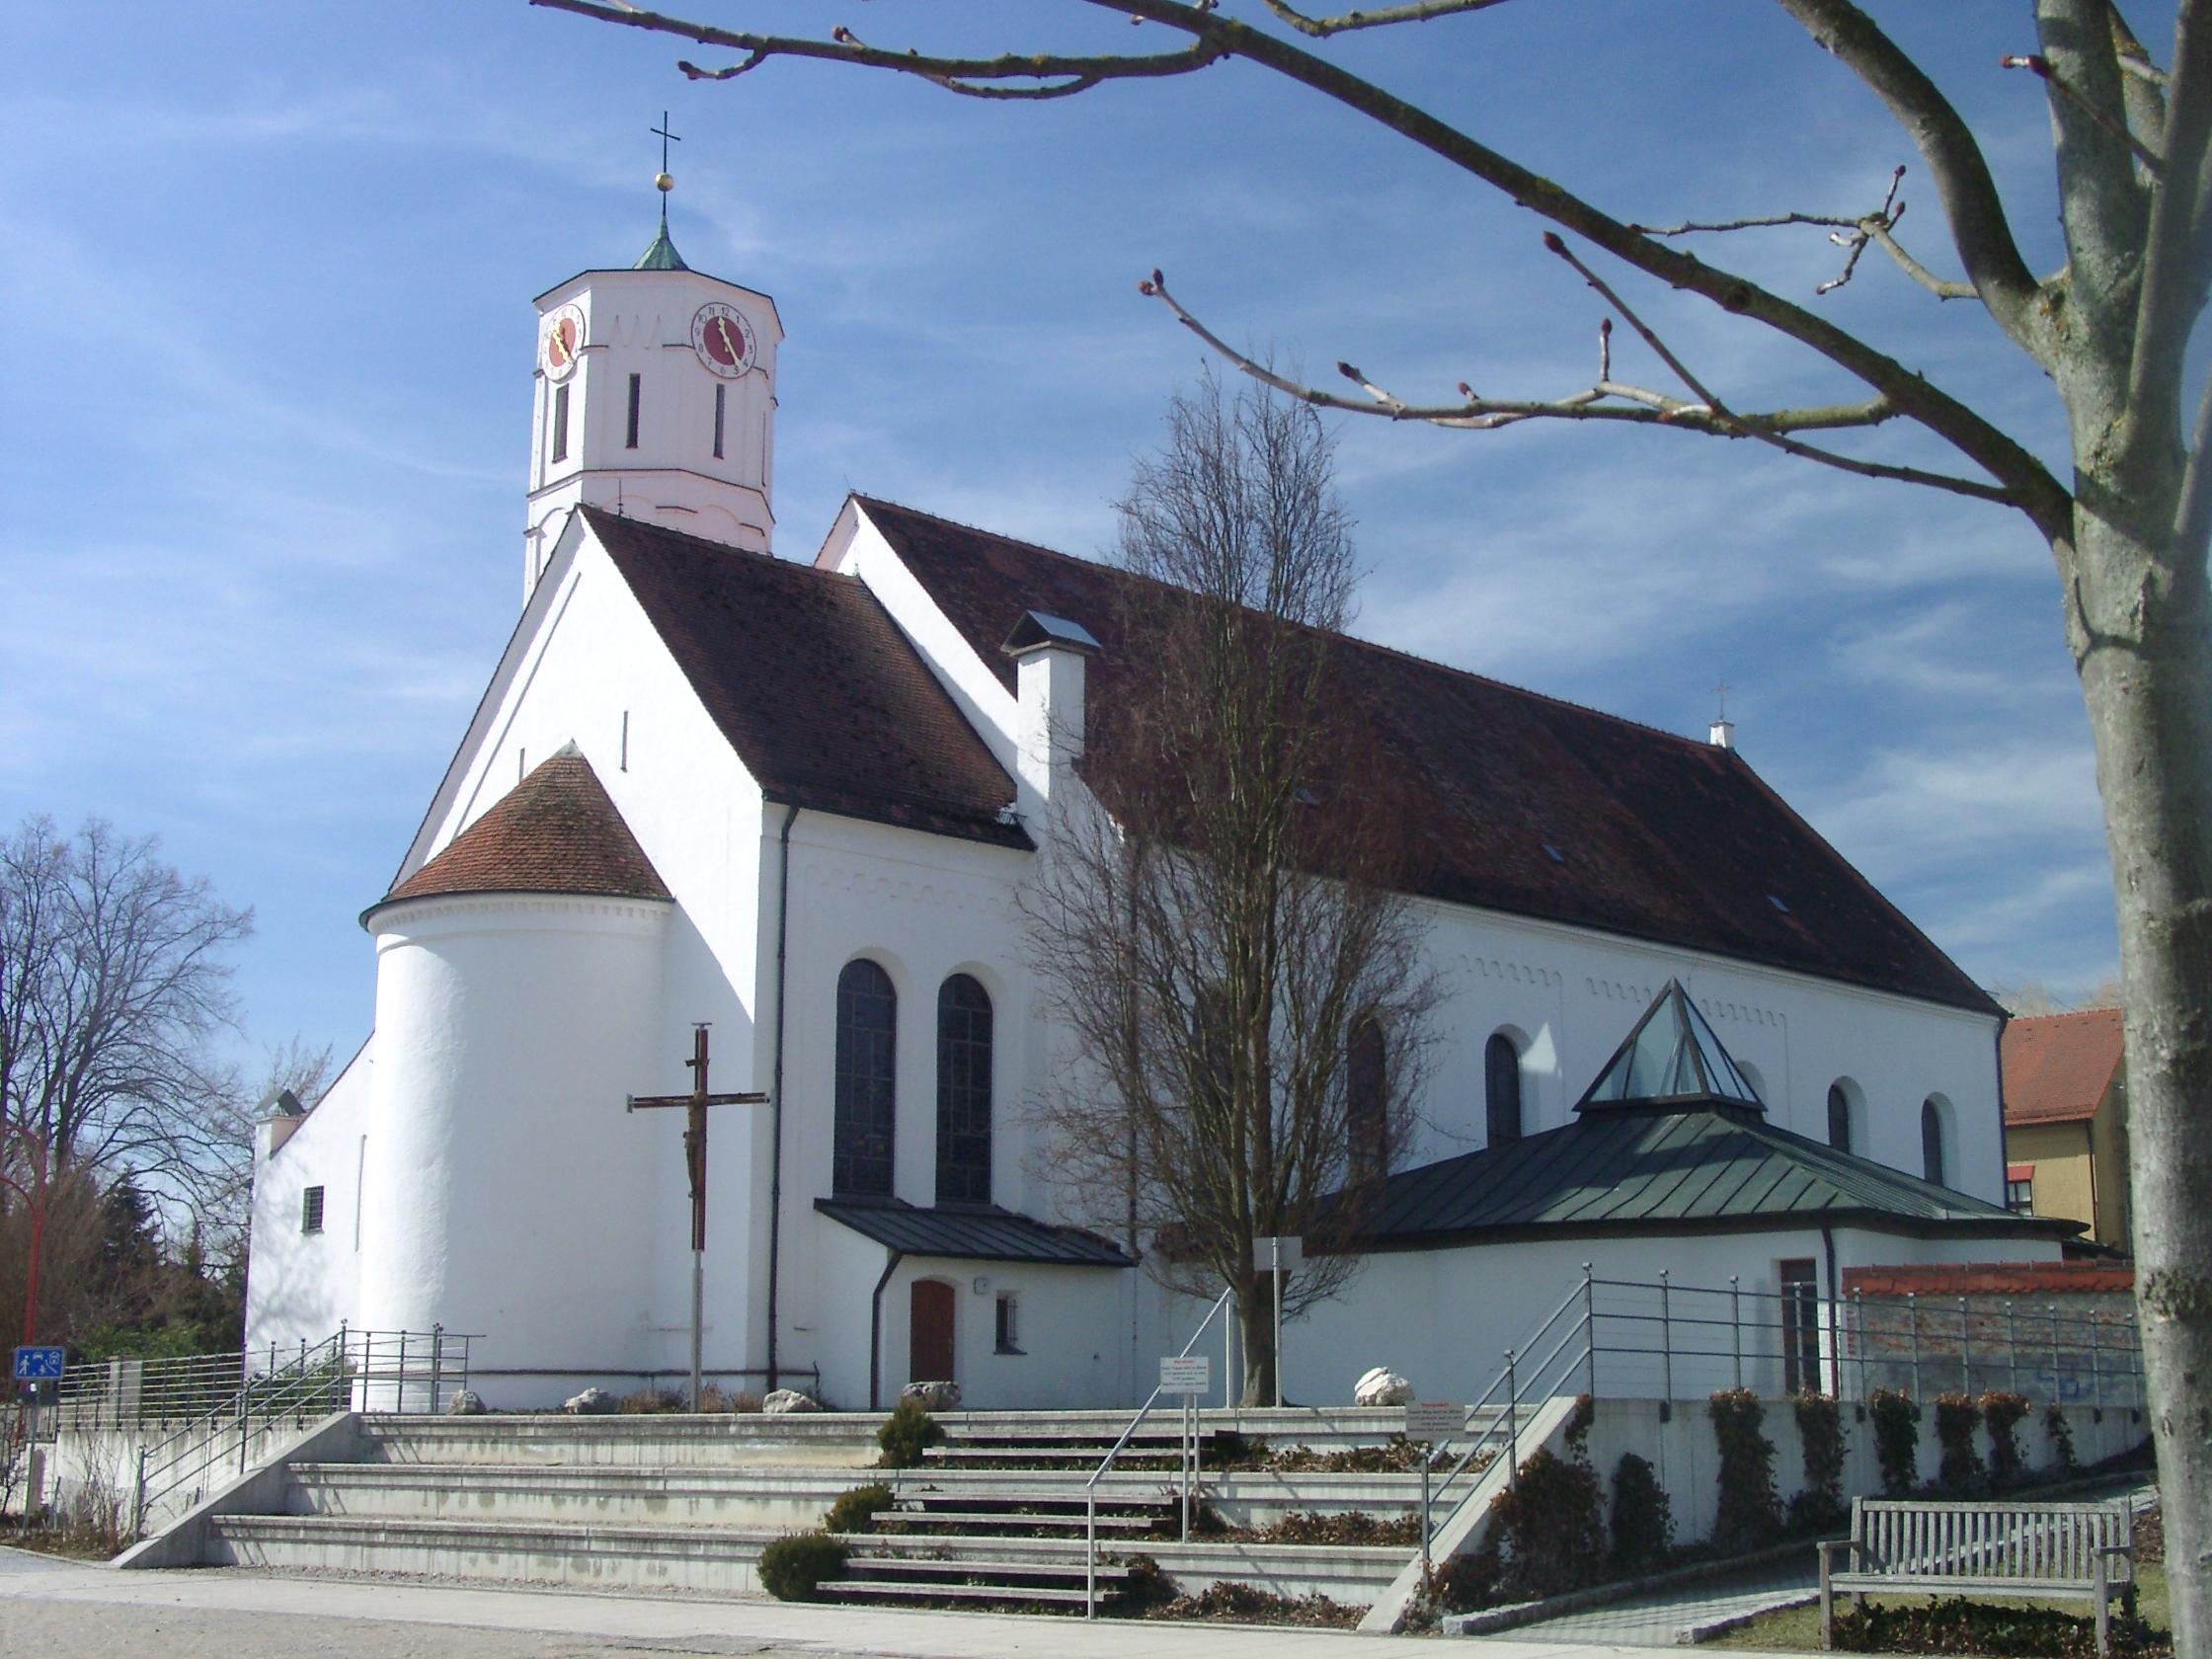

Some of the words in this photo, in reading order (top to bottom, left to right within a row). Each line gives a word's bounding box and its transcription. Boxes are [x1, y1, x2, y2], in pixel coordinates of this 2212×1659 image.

[708, 307, 715, 316] 11
[721, 306, 730, 316] 12
[697, 314, 708, 324] 10
[736, 315, 740, 324] 1
[694, 327, 700, 336] 9
[744, 329, 750, 338] 2
[698, 344, 704, 353] 8
[748, 345, 753, 354] 3
[707, 356, 713, 365] 7
[743, 357, 749, 367] 4
[733, 366, 739, 375] 5
